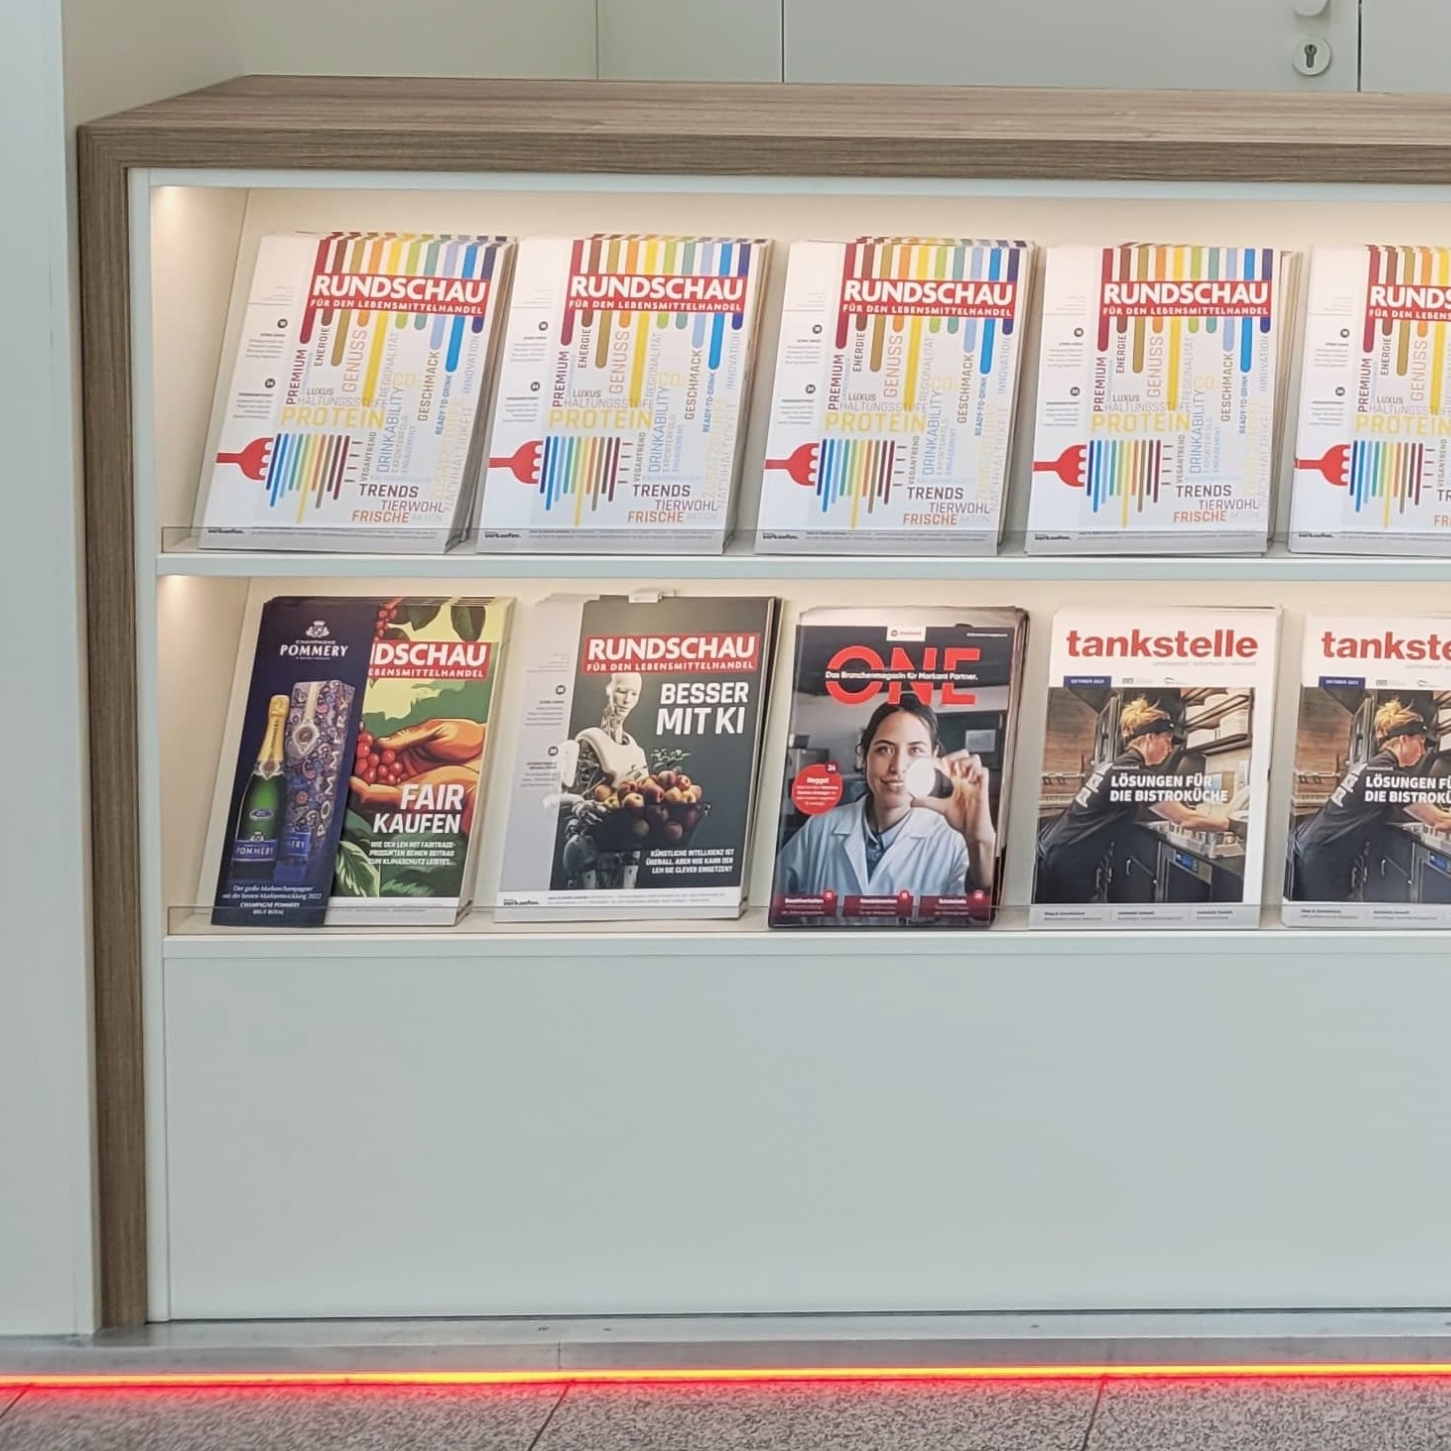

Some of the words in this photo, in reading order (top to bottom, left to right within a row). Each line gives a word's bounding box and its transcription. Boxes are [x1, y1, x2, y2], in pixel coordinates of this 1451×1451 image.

[311, 276, 487, 302] RUNDSCHAU
[570, 277, 743, 299] RUNDSCHAU
[844, 281, 1013, 305] RUNDSCHAU
[1104, 284, 1268, 304] RUNDSCHAU
[309, 298, 329, 308] FÜR
[332, 301, 354, 309] DEN
[358, 301, 484, 314] LEBENSMITTELHANDEL
[569, 299, 588, 309] FÜR
[592, 301, 614, 309] DEN
[618, 301, 742, 311] LEBENSMITTELHANDEL
[843, 303, 862, 313] FÜR
[866, 306, 887, 314] DEN
[891, 305, 1012, 317] LEBENSMITTELHANDEL
[1103, 307, 1121, 315] FÜR
[1150, 307, 1268, 315] LEBENSMITTELHANDEL
[1369, 308, 1387, 318] FÜR
[1391, 311, 1411, 319] DEN
[313, 327, 330, 366] ENERGIE
[578, 328, 591, 368] ENERGIE
[852, 332, 865, 371] ENERGIE
[1115, 334, 1126, 373] ENERGIE
[1380, 336, 1391, 375] ENERGIE
[342, 330, 367, 392] GENUSS
[609, 331, 629, 393] GENUSS
[883, 335, 903, 397] GENUSS
[1147, 336, 1163, 397] GENUSS
[1410, 340, 1427, 400] GENUSS
[286, 349, 306, 404] PREMIUM
[417, 351, 441, 421] GESCHMACK
[553, 351, 569, 407] PREMIUM
[685, 349, 703, 420] GESCHMACK
[828, 355, 844, 410] PREMIUM
[1094, 357, 1106, 411] PREMIUM
[1221, 353, 1234, 421] GESCHMACK
[1358, 358, 1371, 412] PREMIUM
[306, 387, 335, 396] LUXUS
[848, 393, 876, 401] LUXUS
[957, 354, 974, 423] GESCHMACK
[1112, 394, 1139, 402] LUXUS
[281, 406, 386, 429] PROTEIN
[549, 410, 653, 429] PROTEIN
[825, 413, 927, 432] PROTEIN
[1092, 413, 1191, 433] PROTEIN
[376, 387, 405, 472] DRINKABILITY
[648, 387, 671, 472] DRINKABILITY
[922, 391, 944, 475] DRINKABILITY
[1190, 390, 1206, 473] DRINKABILITY
[359, 483, 419, 499] TRENDS
[633, 484, 691, 497] TRENDS
[907, 487, 964, 500] TRENDS
[1176, 485, 1231, 497] TRENDS
[381, 500, 446, 514] TIERWOHL
[655, 499, 718, 511] TIERWOHL
[929, 502, 990, 514] TIERWOHL
[1199, 499, 1259, 510] TIERWOHL
[352, 510, 410, 525] FRISCHE
[628, 511, 684, 523] FRISCHE
[903, 513, 958, 525] FRISCHE
[1174, 511, 1227, 523] FRISCHE
[280, 644, 349, 657] POMMERY
[588, 636, 755, 661] RUNDSCHAU
[1066, 628, 1258, 658] tankstelle
[587, 659, 608, 672] FÜR
[610, 662, 633, 672] DEN
[635, 660, 755, 672] LEBENSMITTELHANDEL
[824, 645, 982, 706] ONE
[825, 671, 840, 679] Das
[841, 671, 906, 681] Branchenmagazin
[907, 672, 918, 680] für
[918, 672, 949, 680] Markant
[660, 681, 750, 705] BESSER
[656, 707, 709, 735] MIT
[715, 707, 746, 735] KI
[1111, 772, 1183, 789] LÖSUNGEN
[1185, 772, 1212, 788] FÜR
[1366, 774, 1437, 791] LÖSUNGEN
[400, 783, 465, 811] FAIR
[1110, 789, 1132, 802] DIE
[1135, 788, 1229, 803] BISTROKÜCHE
[1365, 790, 1387, 803] DIE
[373, 812, 461, 834] KAUFEN
